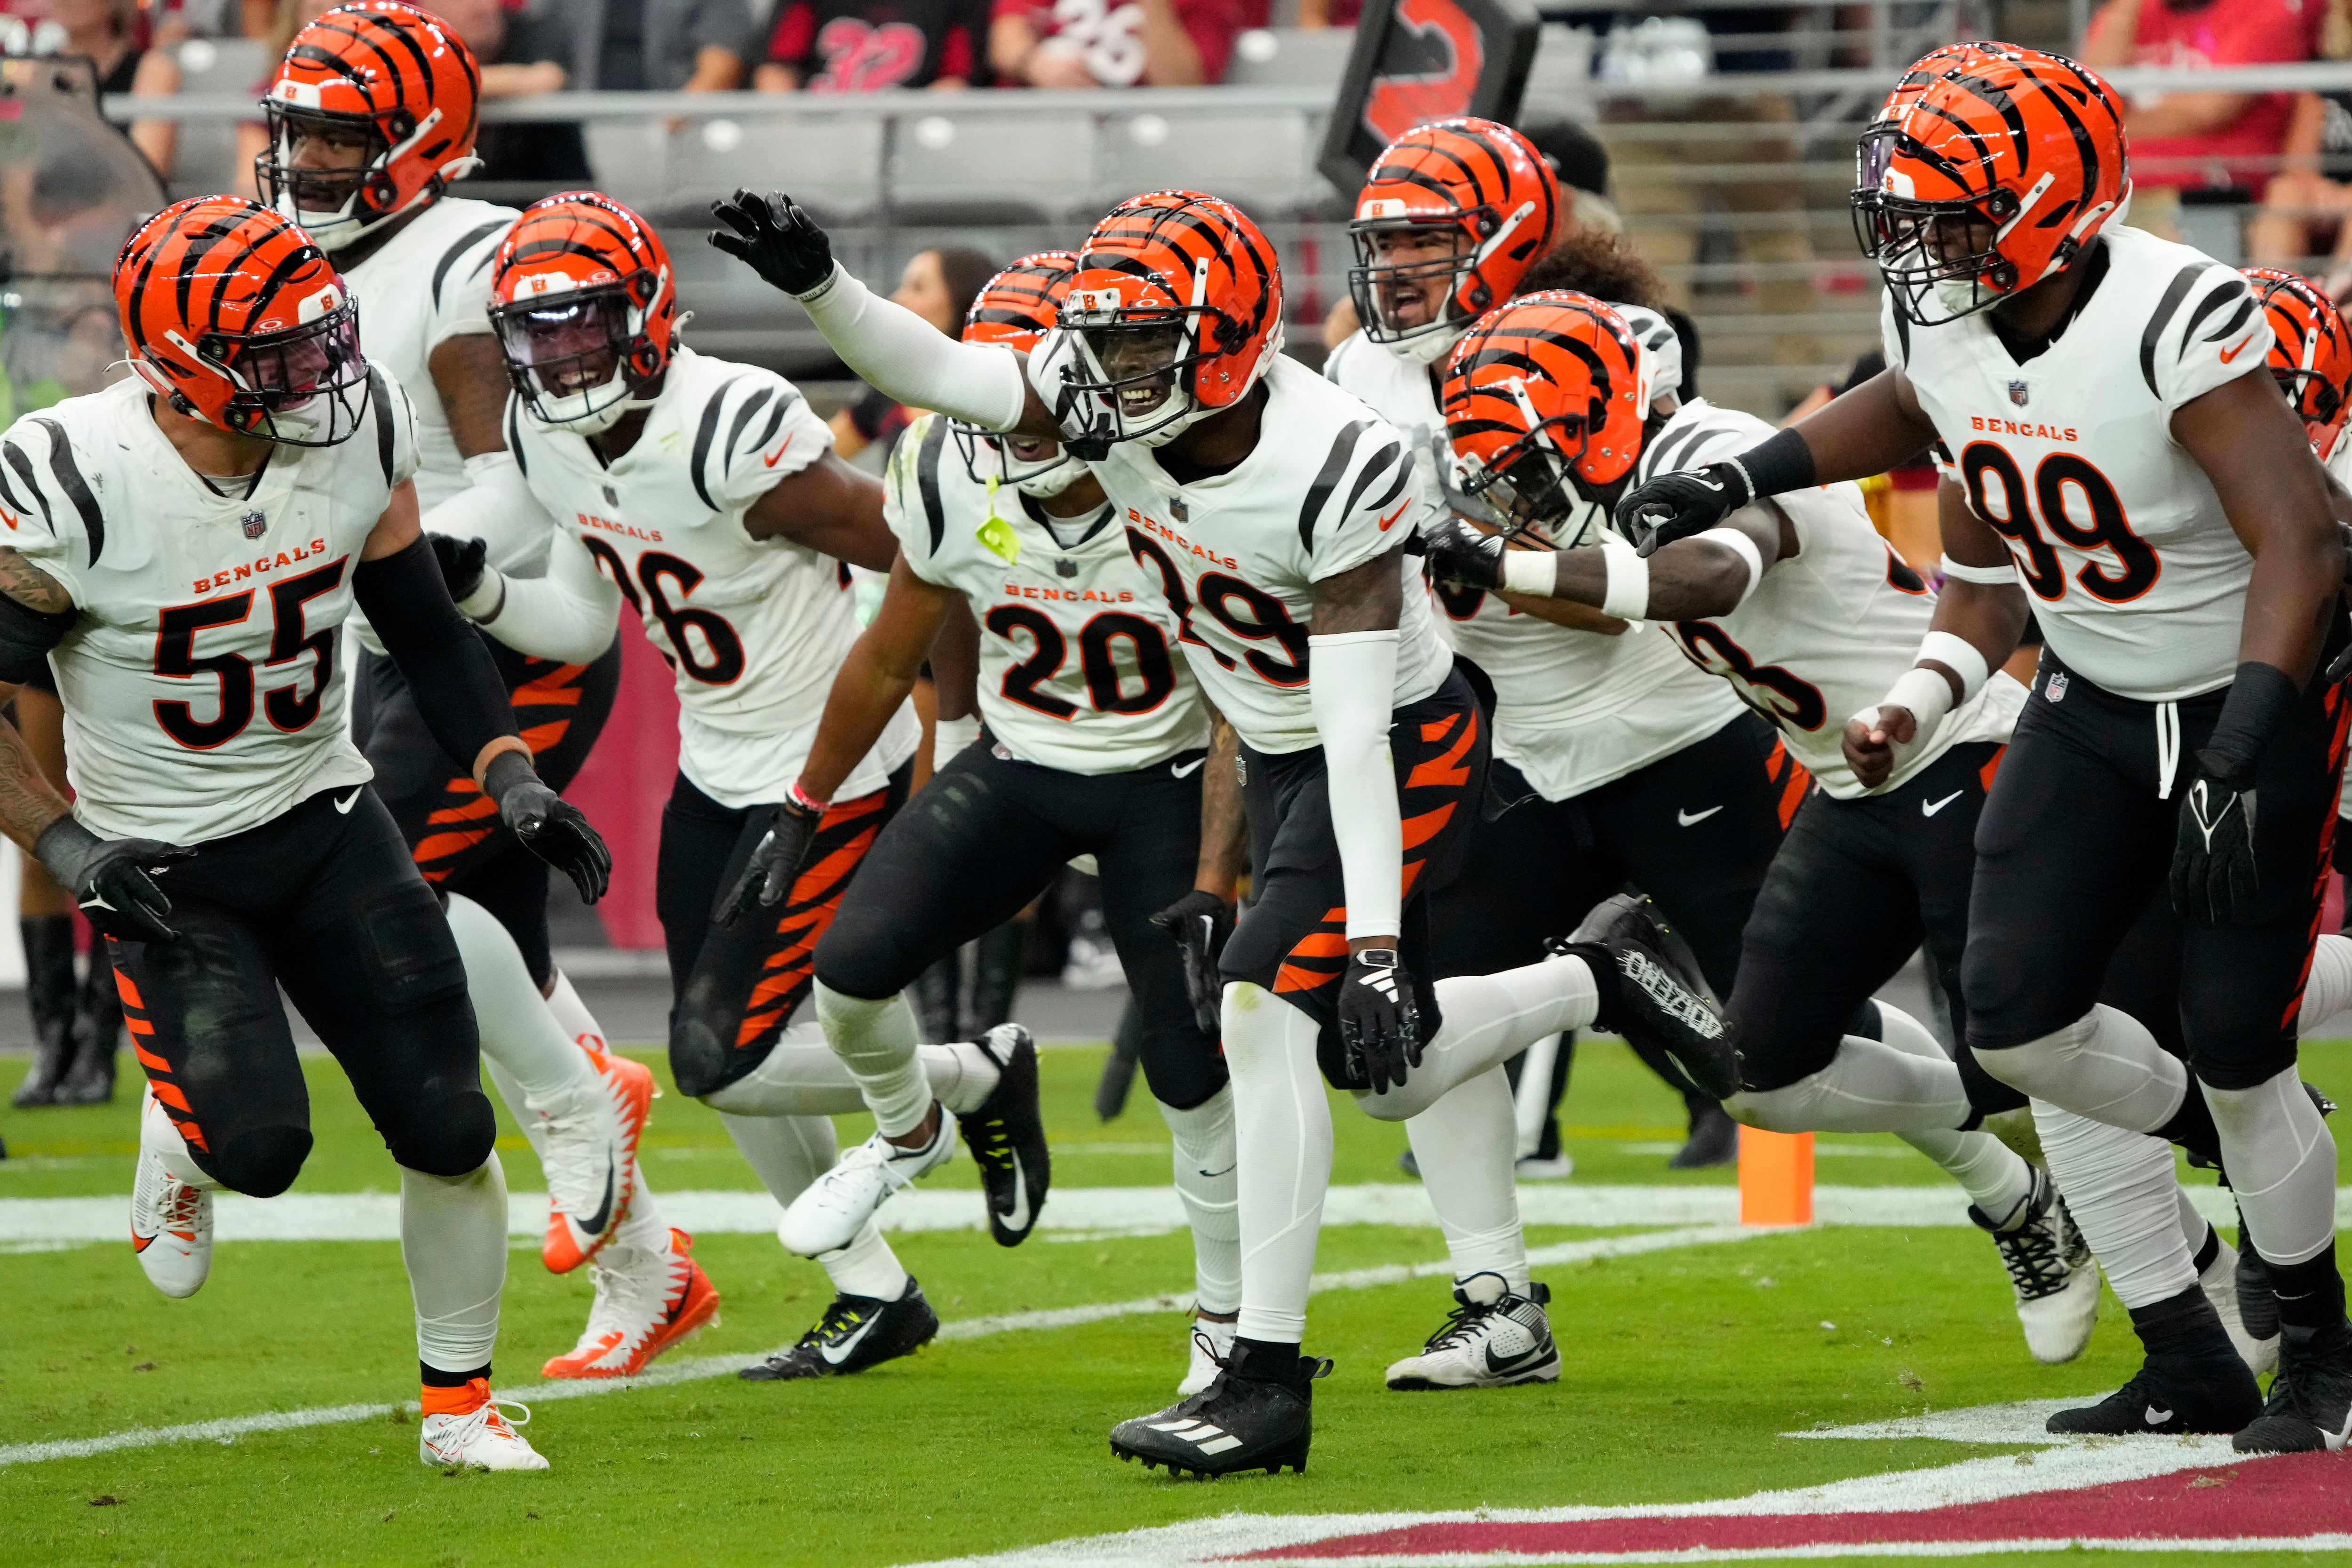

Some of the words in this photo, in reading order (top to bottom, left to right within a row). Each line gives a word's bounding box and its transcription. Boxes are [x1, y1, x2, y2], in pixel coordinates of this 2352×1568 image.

[1971, 416, 2078, 442] BENGALS
[577, 512, 663, 542] BENGALS
[1128, 508, 1239, 570] BENGALS
[1961, 440, 2161, 604] 99
[193, 538, 326, 594] BENGALS
[1005, 584, 1134, 603] BENGALS
[1124, 525, 1310, 687] 29
[152, 553, 350, 750] 55
[985, 603, 1176, 722] 20
[1659, 619, 1827, 732] 3
